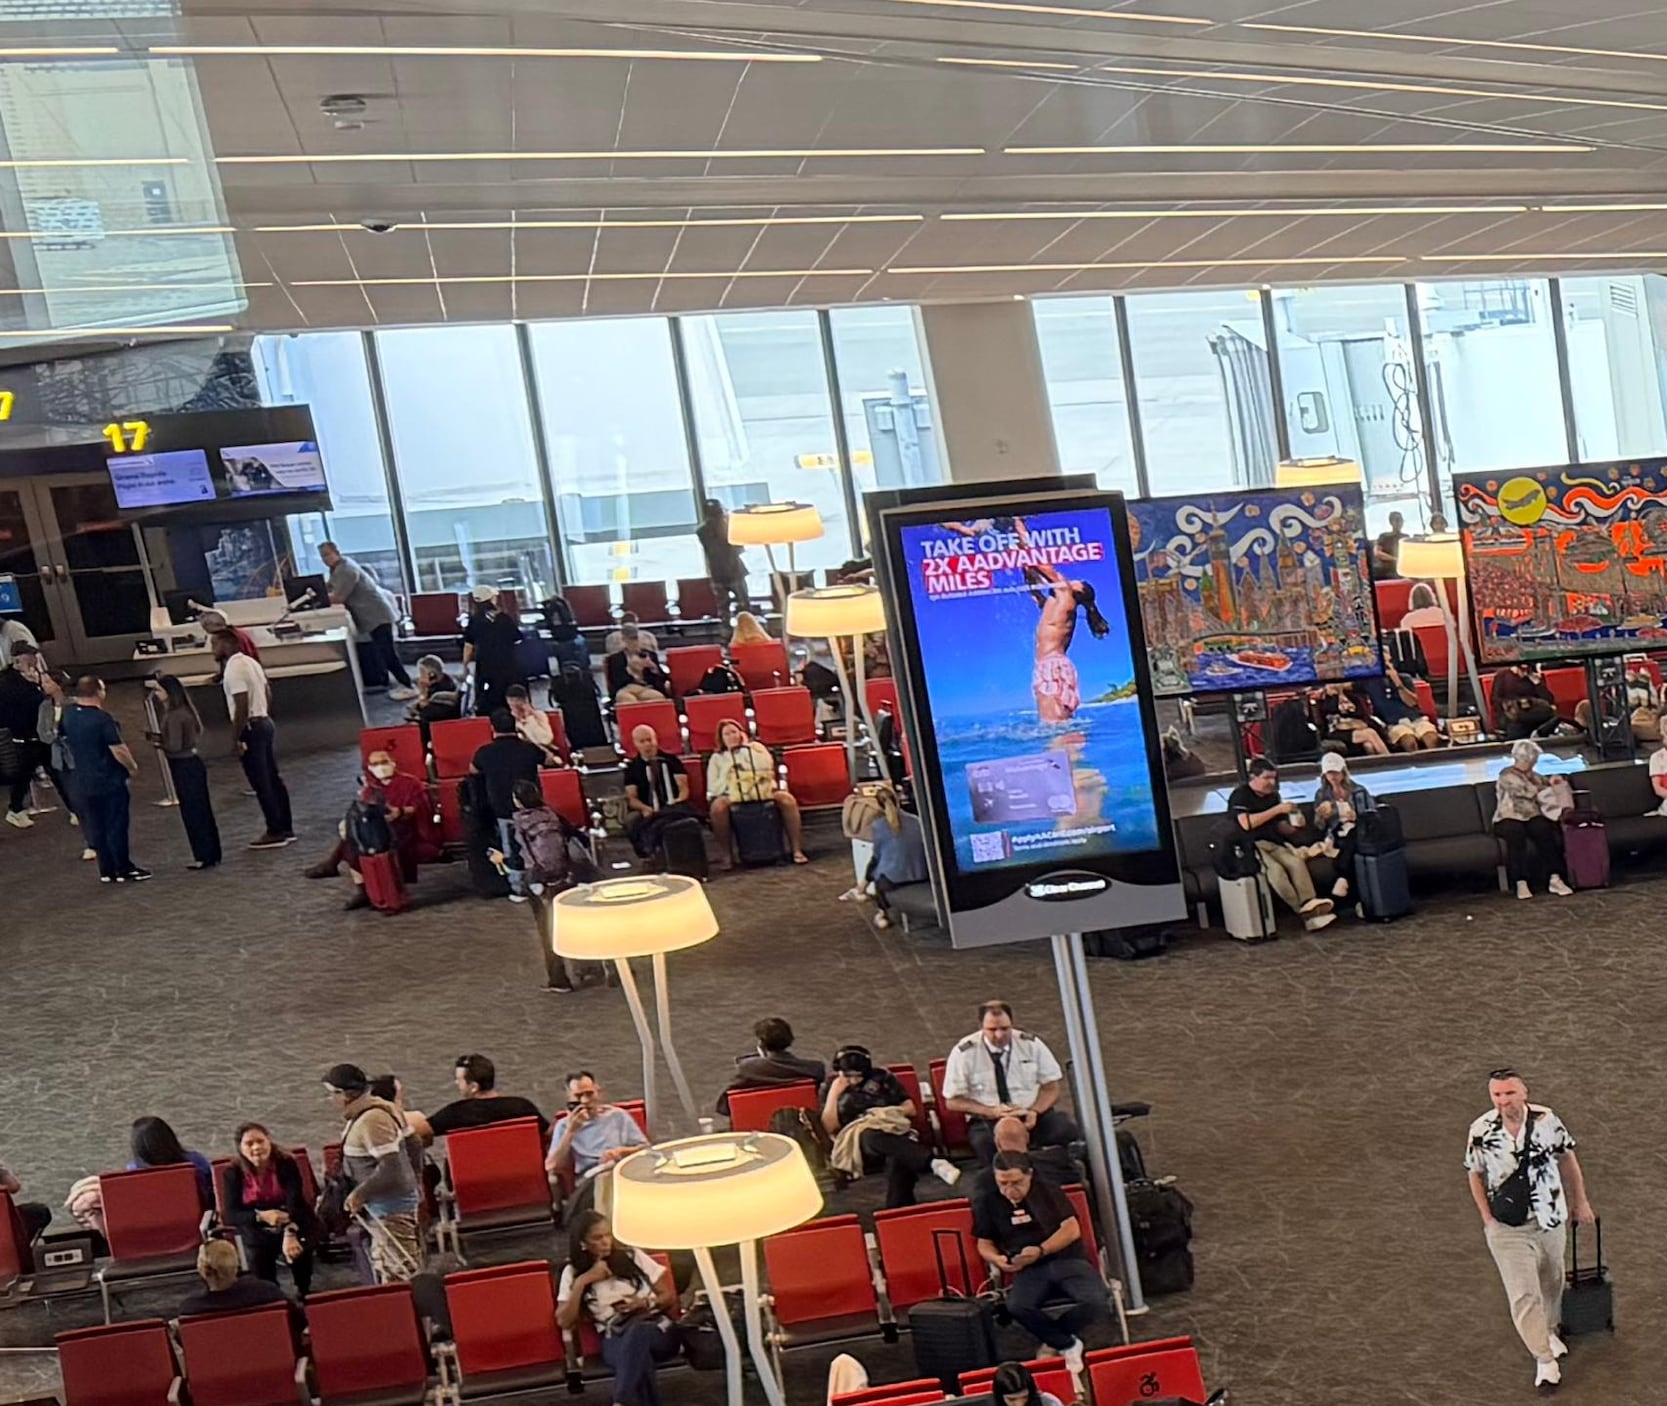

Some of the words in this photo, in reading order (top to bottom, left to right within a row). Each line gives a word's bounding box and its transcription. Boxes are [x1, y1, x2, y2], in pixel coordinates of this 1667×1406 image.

[0, 391, 14, 420] 7
[102, 421, 148, 452] 17
[921, 536, 976, 558] TAKE
[979, 532, 1020, 553] OFF
[1025, 526, 1081, 548] WITH
[924, 559, 951, 576] 2X
[957, 543, 1102, 573] AADVANTAGE
[927, 571, 990, 594] MILES
